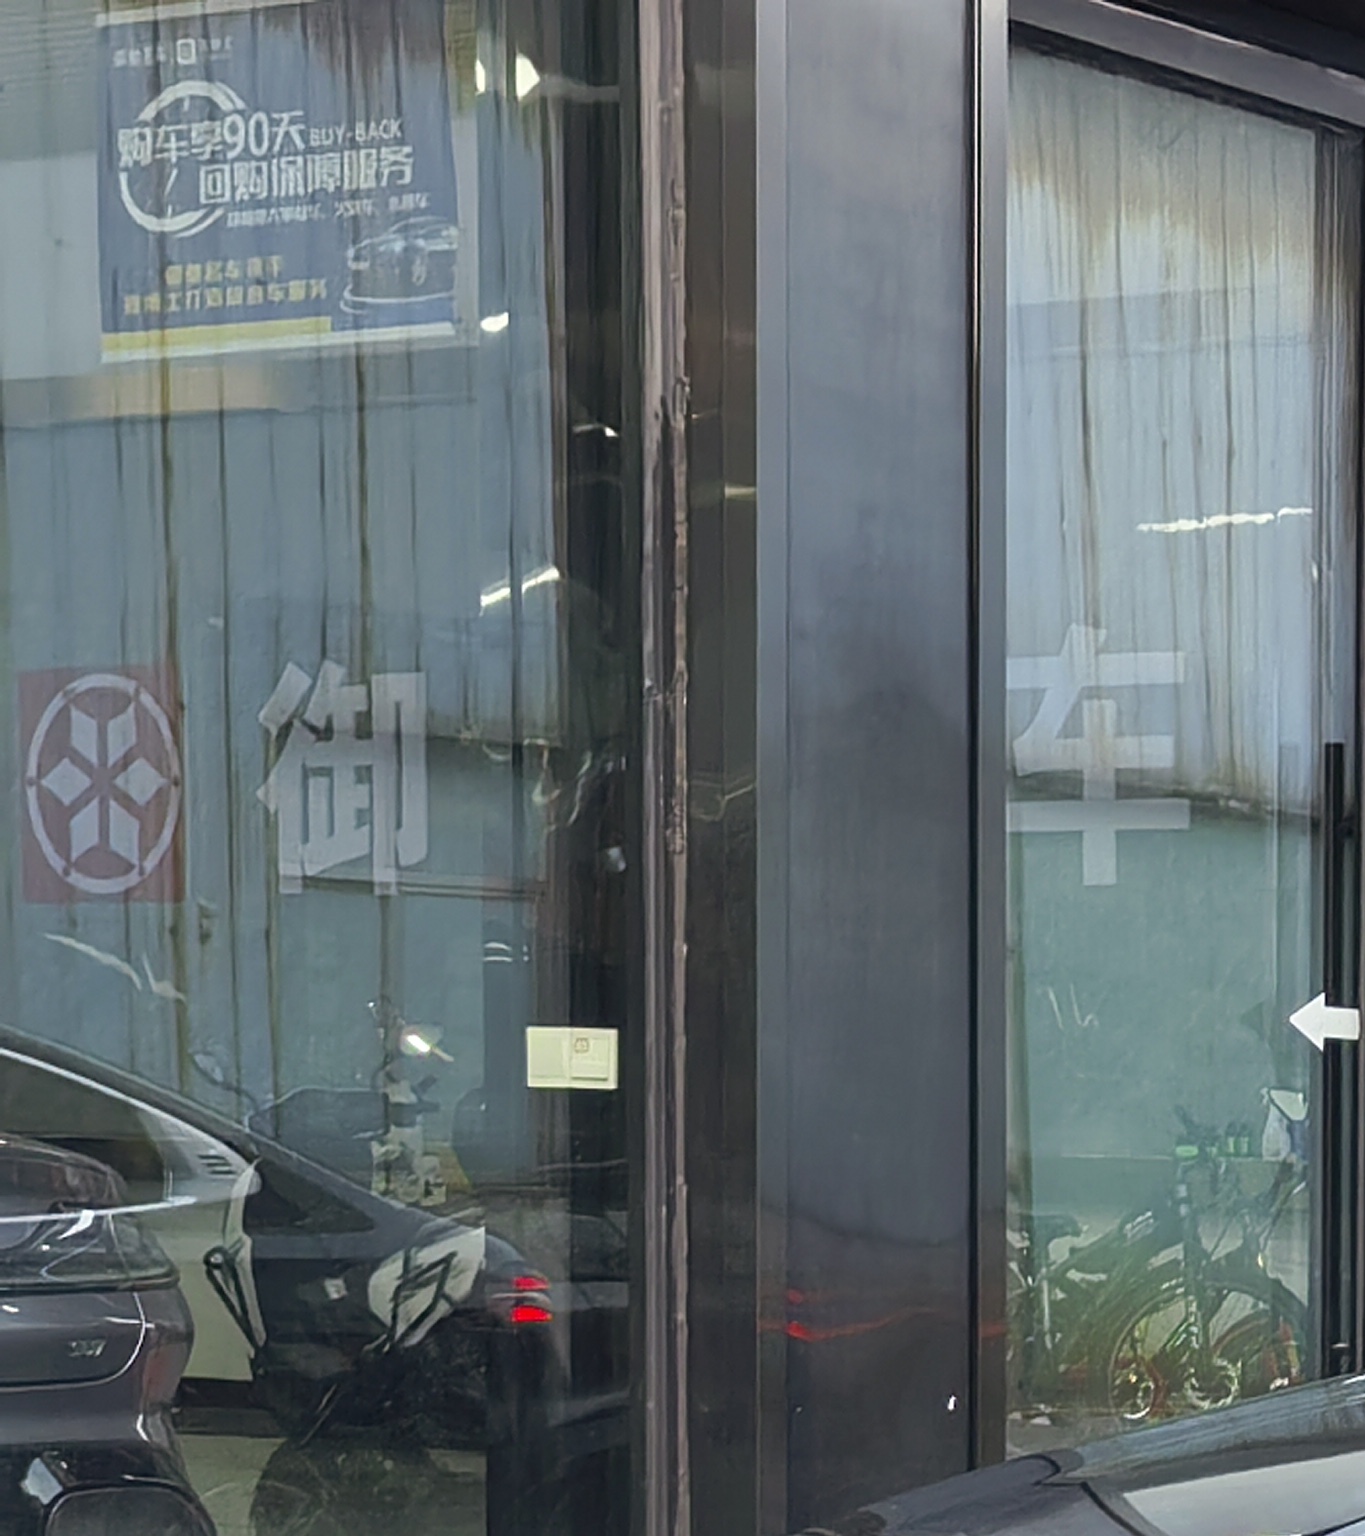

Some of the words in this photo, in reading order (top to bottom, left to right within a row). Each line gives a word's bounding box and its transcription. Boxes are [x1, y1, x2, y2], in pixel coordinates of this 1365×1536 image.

[200, 145, 415, 205] 回购保障服务
[256, 659, 429, 897] 御
[1006, 625, 1192, 887] 车
